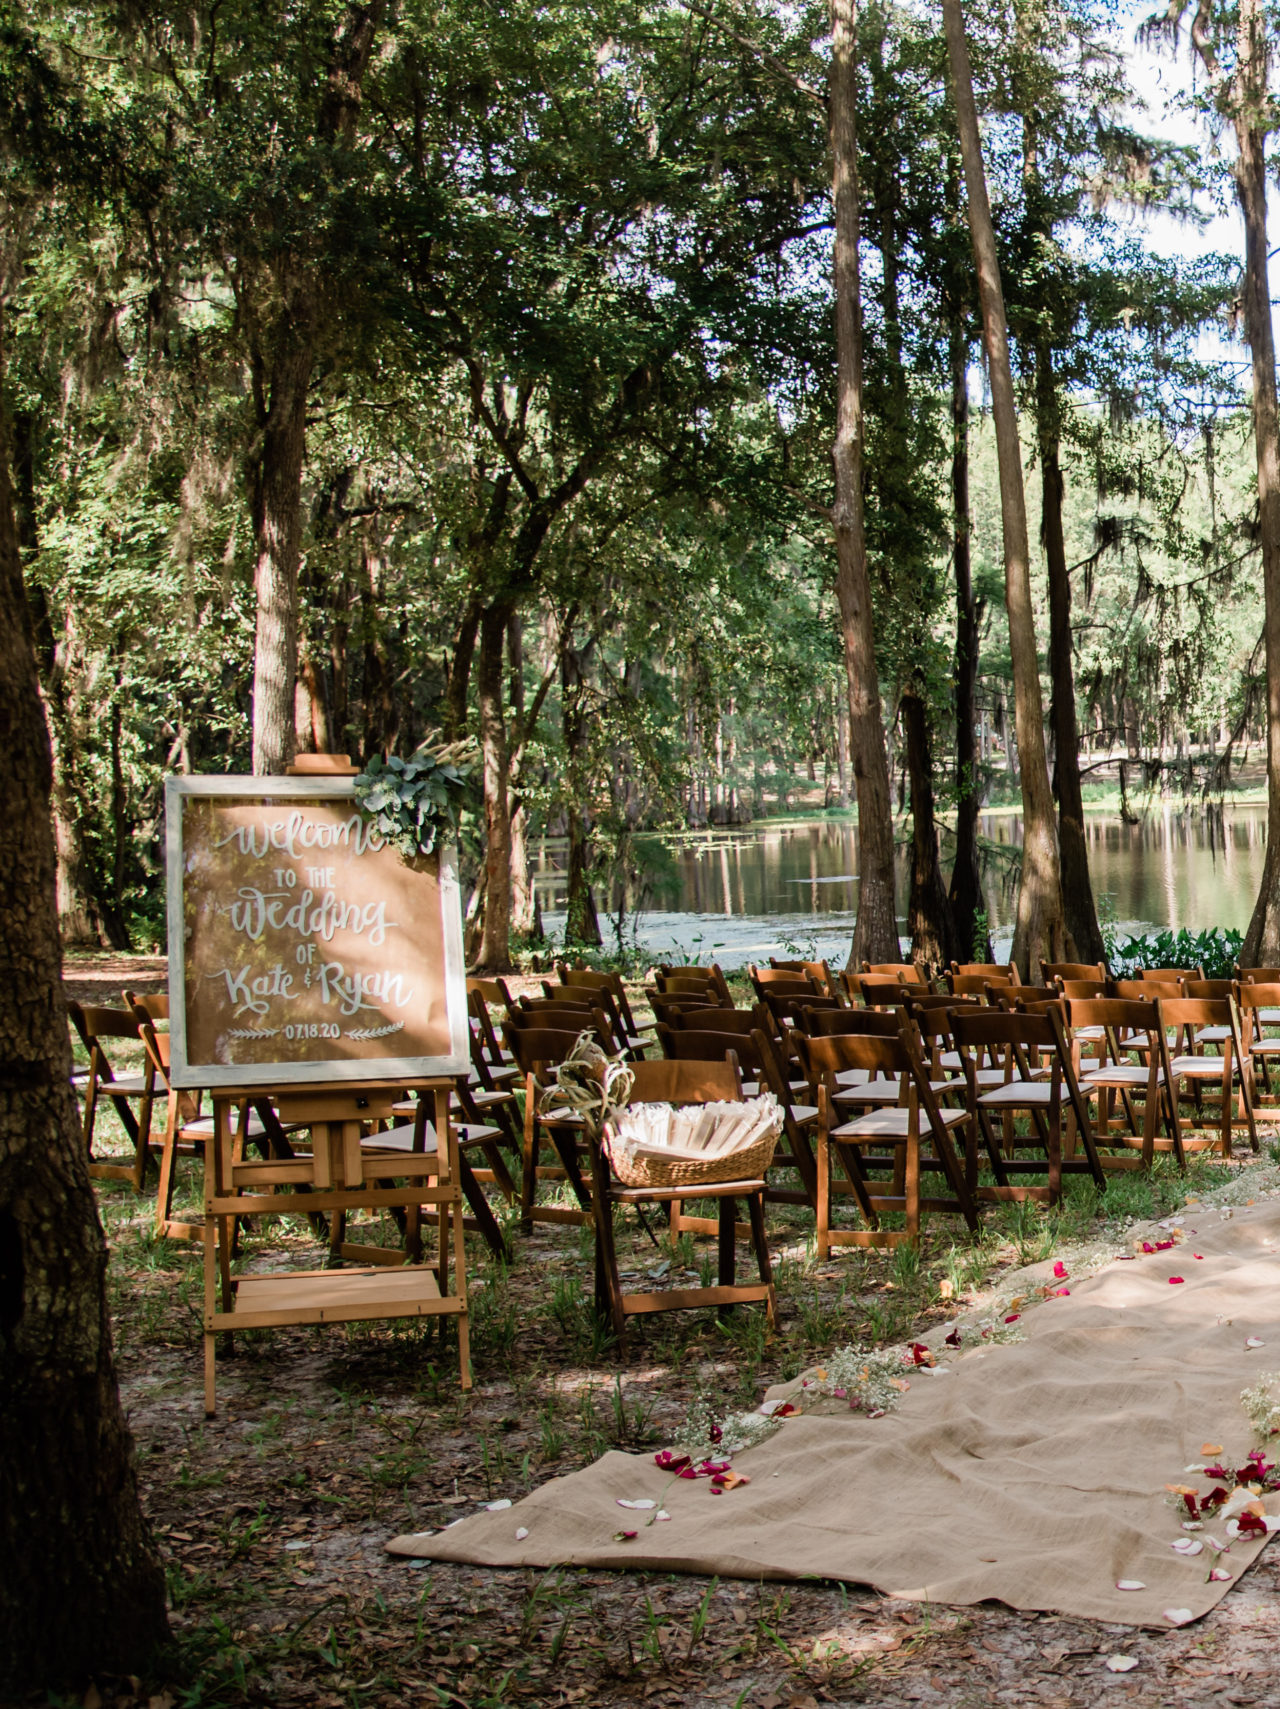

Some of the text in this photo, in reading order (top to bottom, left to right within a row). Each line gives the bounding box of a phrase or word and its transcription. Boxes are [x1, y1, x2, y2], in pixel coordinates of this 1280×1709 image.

[274, 867, 336, 889] TO THE
[220, 887, 398, 946] Wedding
[296, 944, 317, 965] OF
[206, 962, 415, 1019] Kate & Ryan
[285, 1022, 341, 1040] 07.18.20
